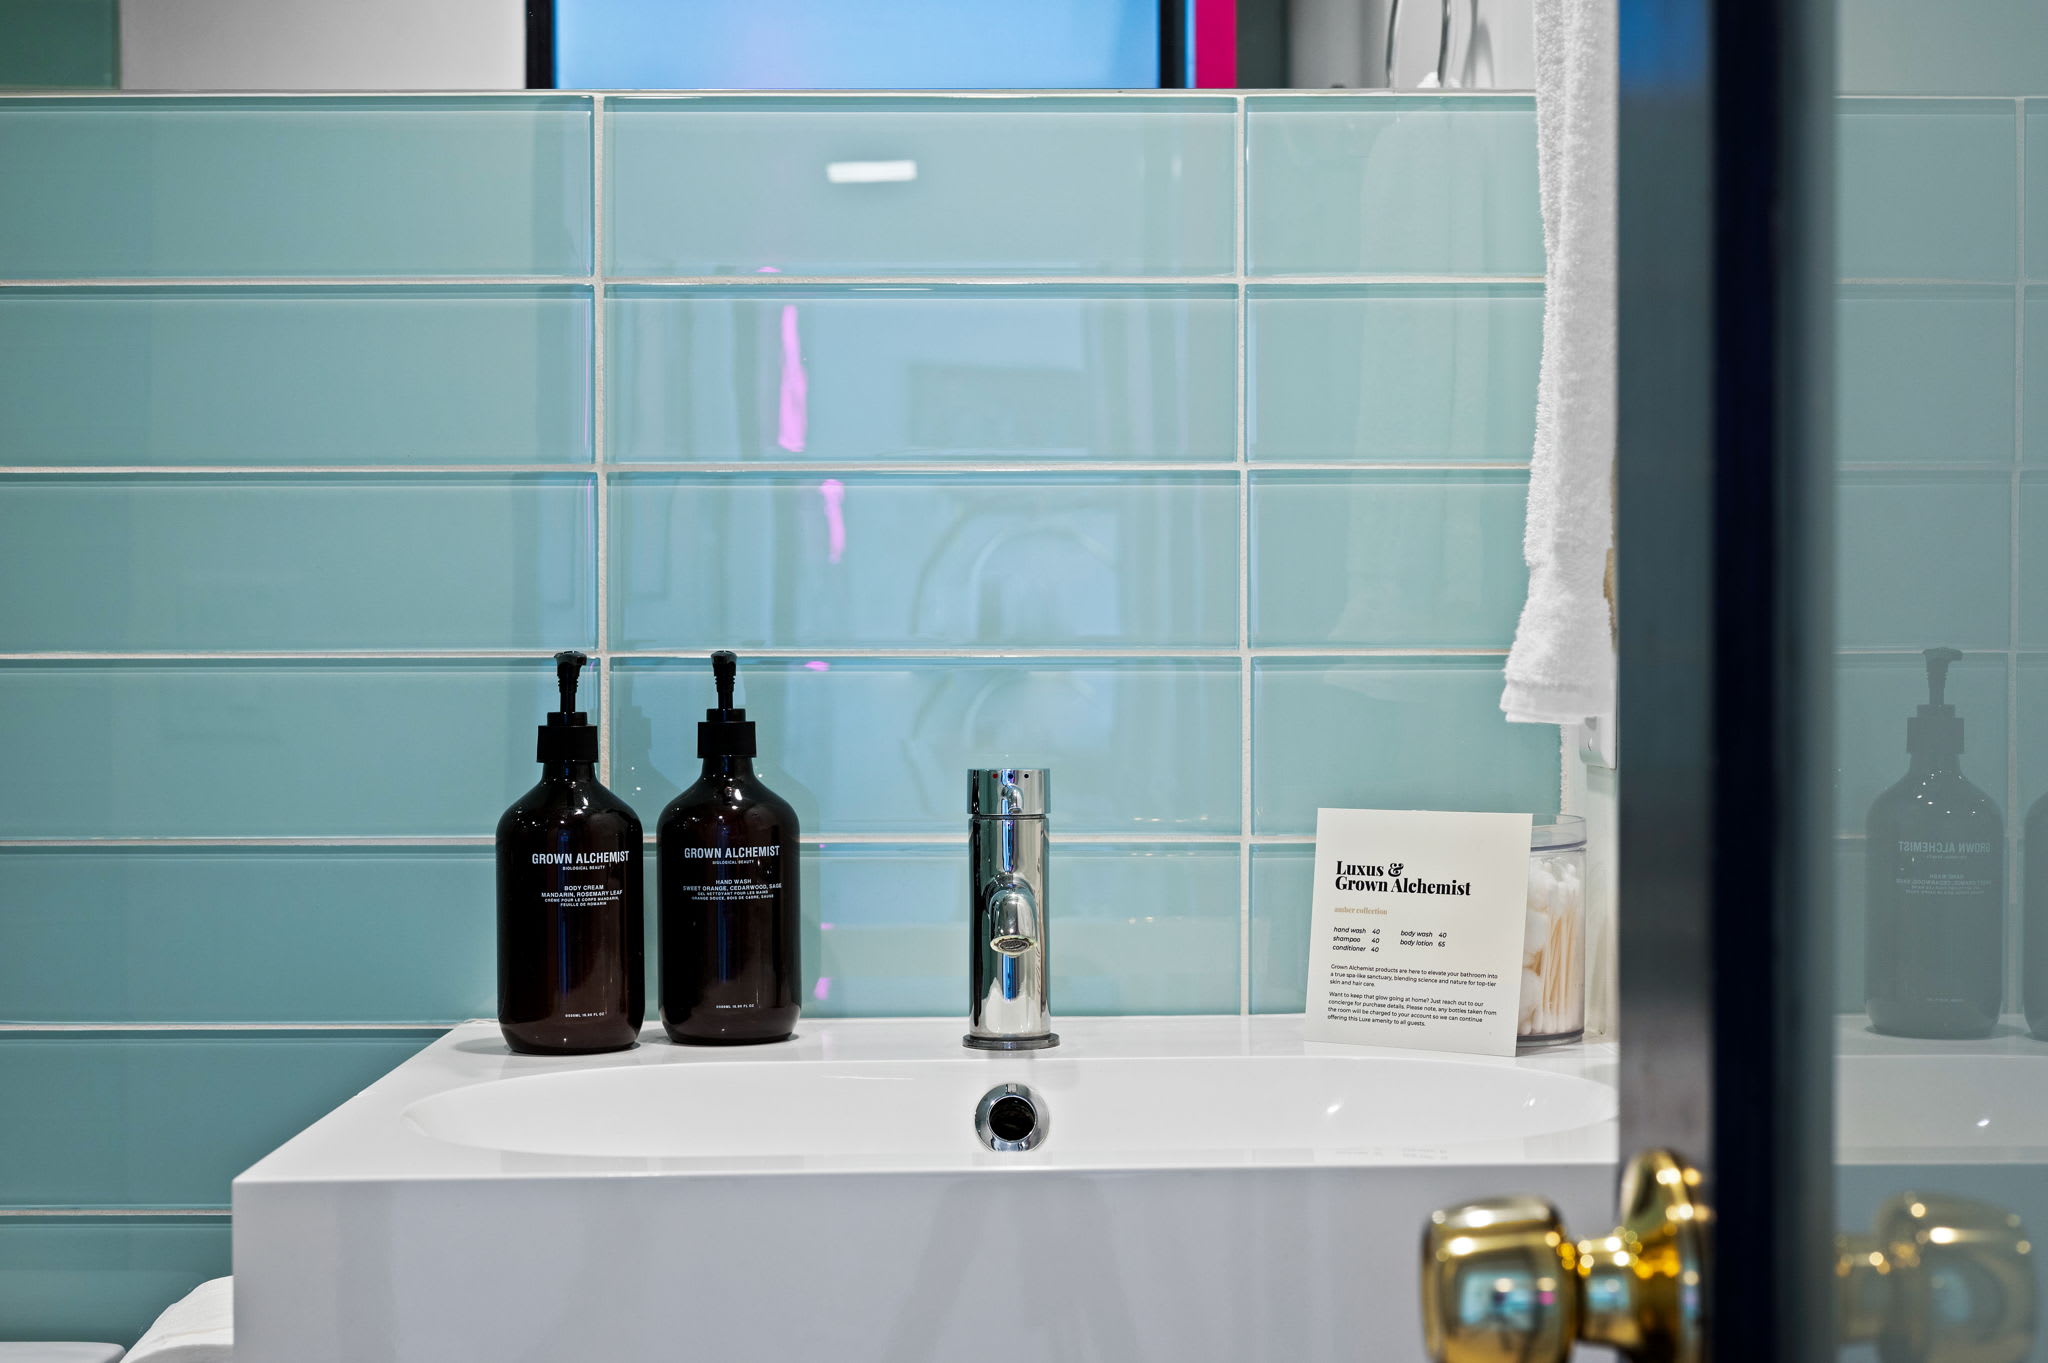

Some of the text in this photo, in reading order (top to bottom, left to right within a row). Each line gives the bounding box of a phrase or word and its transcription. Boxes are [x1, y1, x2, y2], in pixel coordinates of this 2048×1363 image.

[532, 851, 629, 864] GROWN ALCHEMIST
[684, 846, 780, 858] GROWN ALCHEMIST
[1336, 861, 1404, 877] Luxus &
[1335, 876, 1471, 896] Grown Alchemist
[1356, 907, 1387, 915] collection
